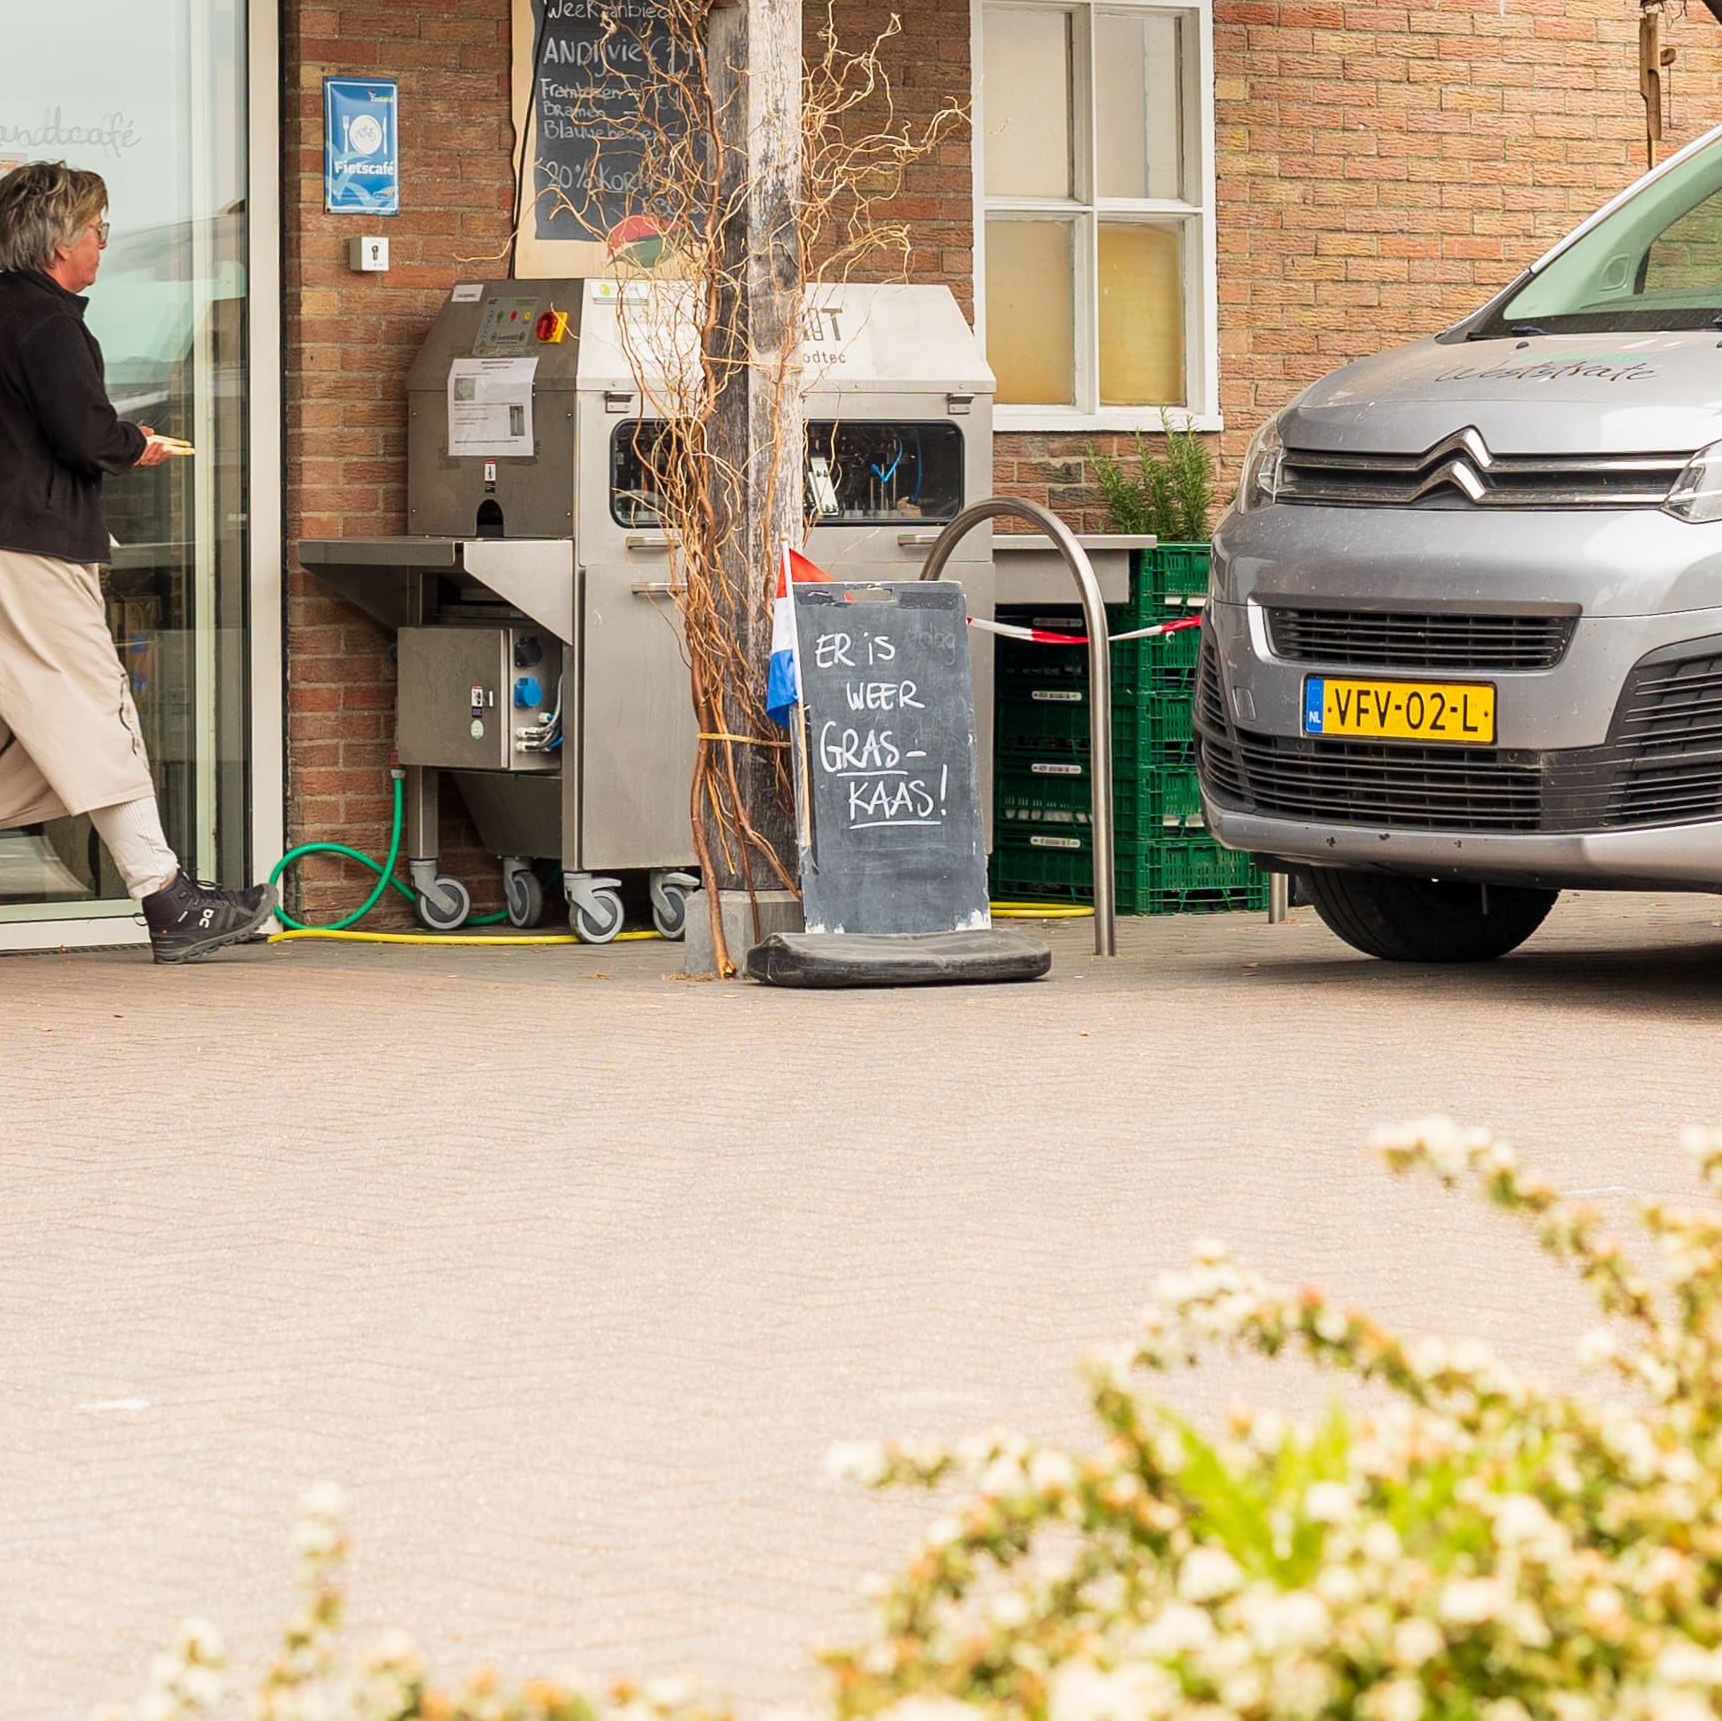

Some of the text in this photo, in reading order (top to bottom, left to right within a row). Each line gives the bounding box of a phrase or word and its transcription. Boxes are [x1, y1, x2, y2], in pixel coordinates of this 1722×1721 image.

[334, 159, 394, 176] Fietscafé
[1435, 359, 1658, 382] Weststrate
[815, 632, 856, 668] ER
[863, 632, 896, 666] iS
[846, 680, 926, 711] WEER
[1335, 688, 1479, 732] VFV-02-L
[1309, 711, 1322, 723] NL
[848, 764, 948, 820] KAAS!
